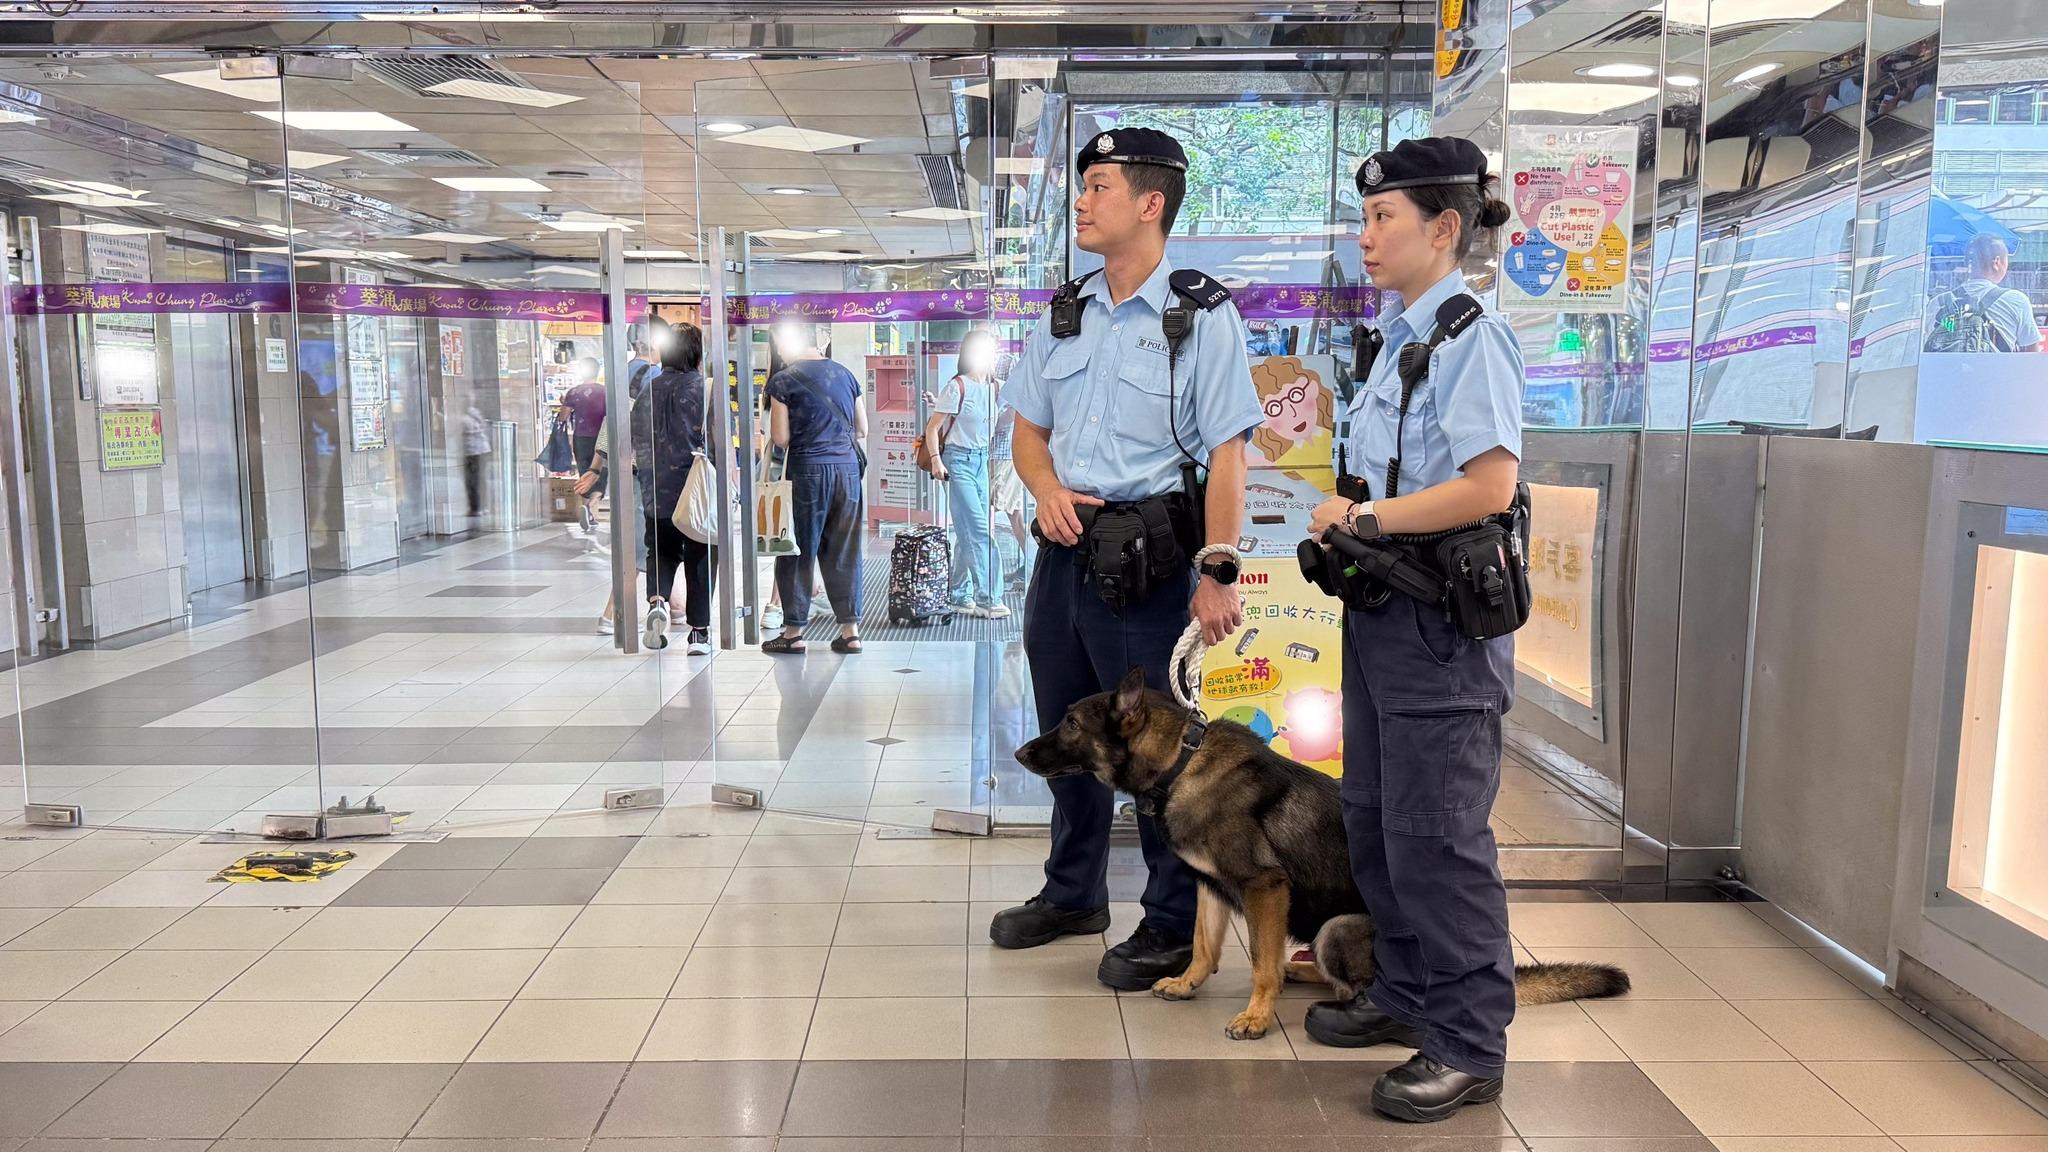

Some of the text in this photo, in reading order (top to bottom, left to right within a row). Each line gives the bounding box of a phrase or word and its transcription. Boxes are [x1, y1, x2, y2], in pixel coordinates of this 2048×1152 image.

[1540, 222, 1594, 230] Cut Plastic
[1554, 233, 1575, 242] Use!
[1576, 240, 1593, 248] April
[65, 287, 235, 309] 葵涌廣場 Kwai Chung Plaza
[360, 288, 557, 315] 葵涌廣場 Kwai Chung Plaza
[1208, 290, 1226, 304] 5272
[801, 304, 838, 318] Chung
[842, 302, 875, 317] Plaza
[1147, 340, 1170, 354] POLIC
[1242, 604, 1344, 628] 兜回收大行
